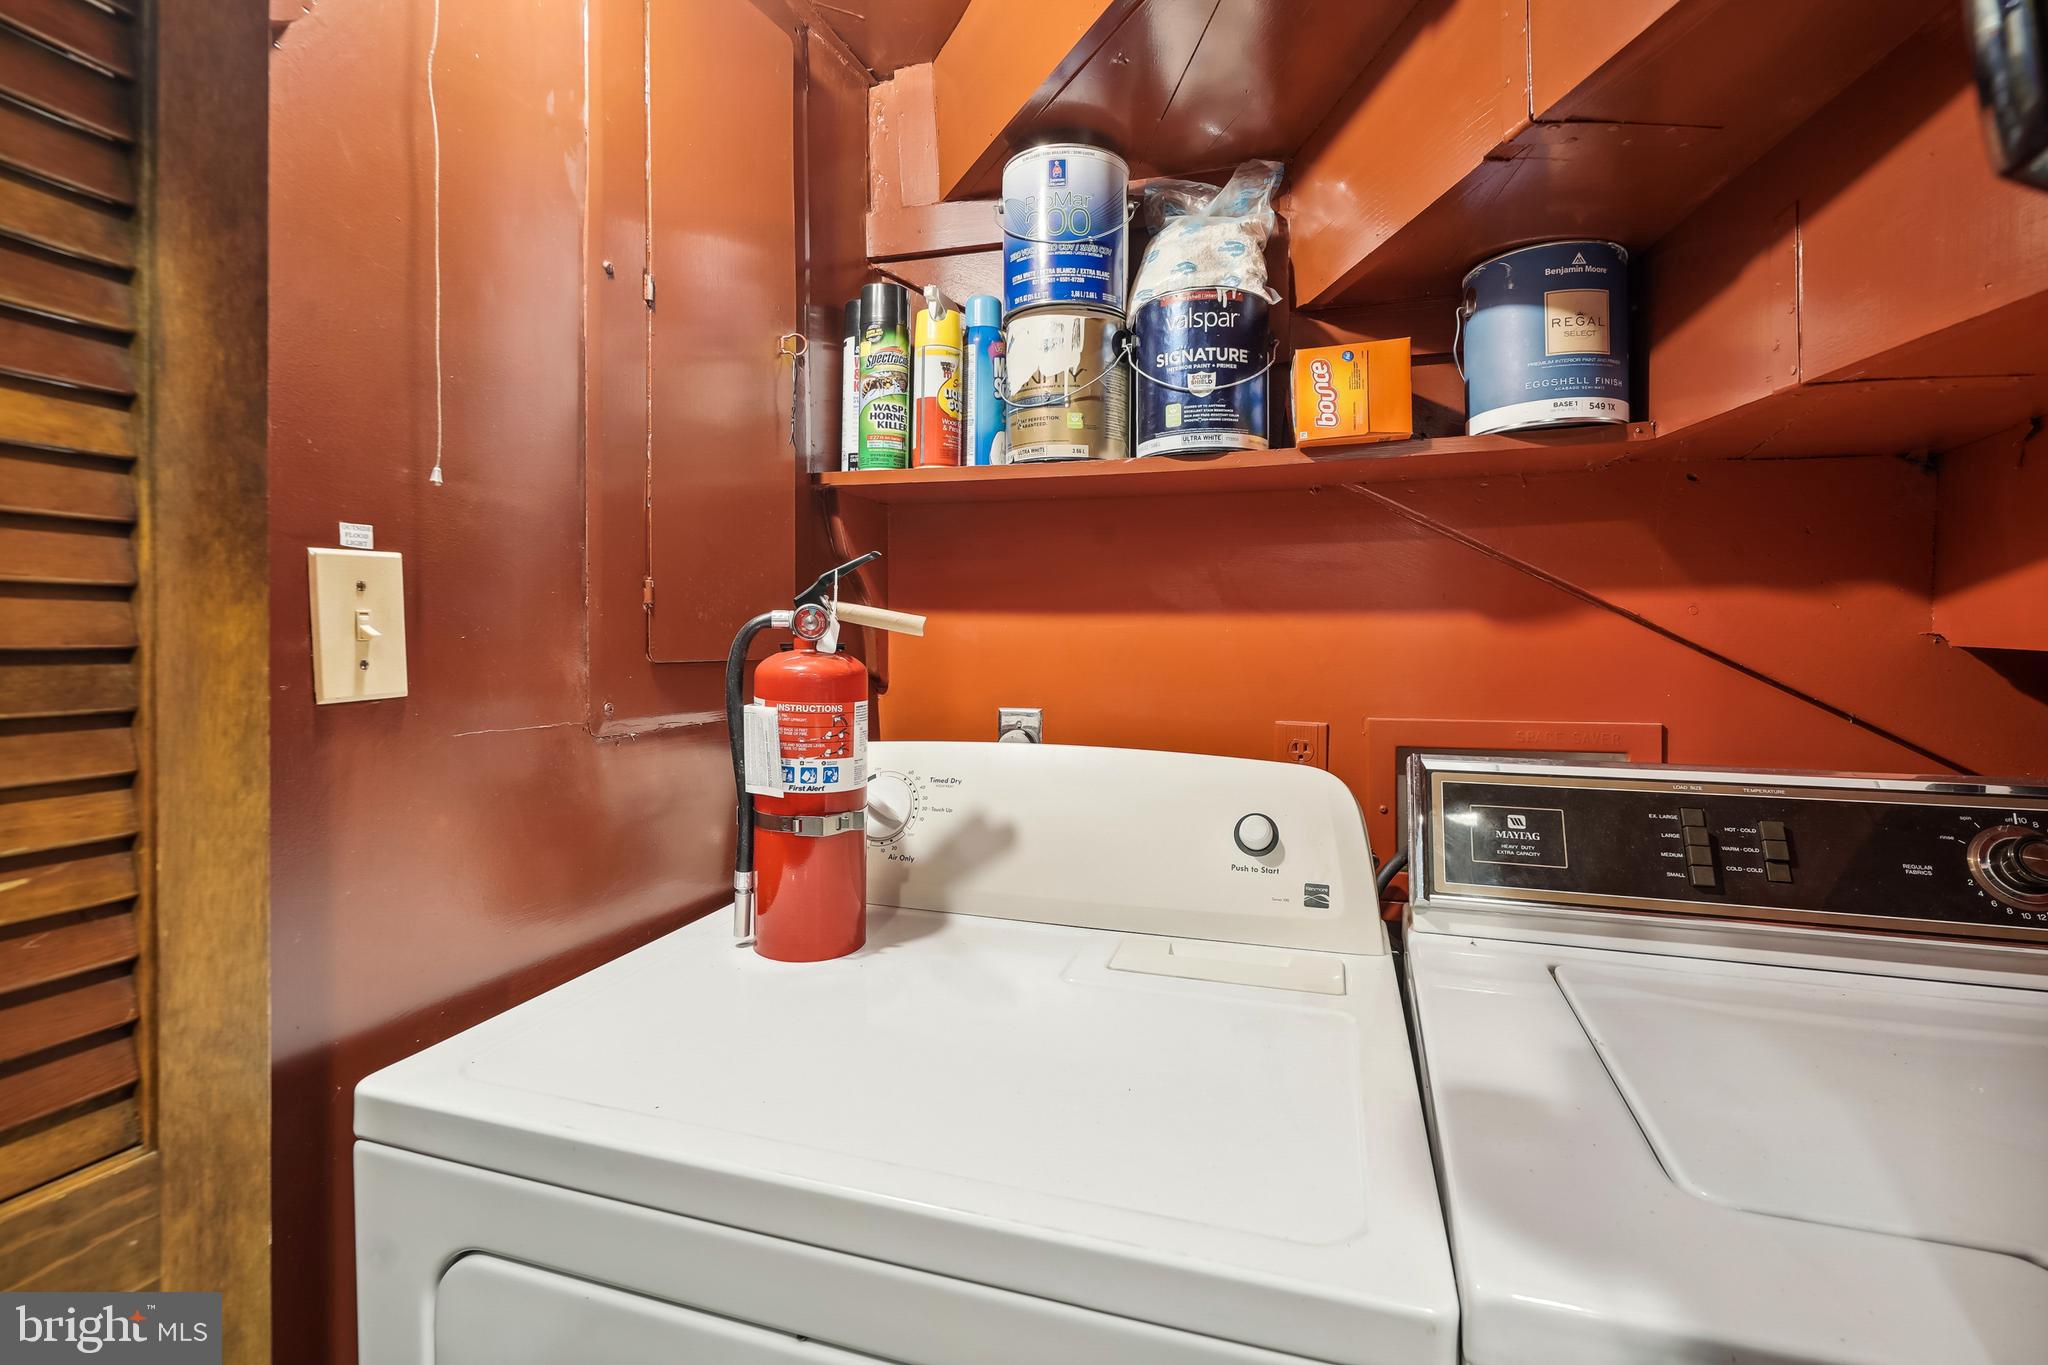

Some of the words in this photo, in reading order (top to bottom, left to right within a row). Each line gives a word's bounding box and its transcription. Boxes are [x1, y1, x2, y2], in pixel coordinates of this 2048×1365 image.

[1024, 191, 1091, 211] ProMar
[1025, 208, 1092, 238] 200
[1080, 268, 1095, 276] EXTRA
[1545, 264, 1583, 276] Benjamin
[1584, 264, 1608, 274] Moore
[1165, 306, 1237, 333] valspar
[1551, 315, 1605, 328] REGAL
[1563, 329, 1596, 338] SELECT
[866, 351, 908, 369] Spectrac
[1156, 346, 1249, 368] SIGNATURE
[1525, 376, 1590, 390] EGGSHELL
[1595, 376, 1622, 388] FINISH
[1310, 359, 1339, 428] bounce
[873, 403, 903, 414] WASP
[1553, 400, 1574, 408] BASE
[1589, 402, 1606, 410] 549
[1607, 403, 1616, 411] 1X
[777, 703, 843, 713] INSTRUCTIONS
[929, 776, 949, 784] Timed
[950, 777, 963, 785] Dry
[788, 784, 806, 792] First
[1743, 787, 1786, 795] TEMPERATURE
[1495, 830, 1541, 841] MAYTAG
[888, 853, 898, 861] Air
[899, 854, 915, 863] Only
[1231, 863, 1249, 872] Push
[1260, 866, 1280, 875] Start
[1902, 863, 1933, 871] REGULAR
[1967, 878, 1974, 886] 2
[2006, 907, 2014, 915] 8
[2021, 912, 2032, 920] 10
[2036, 913, 2047, 921] 12
